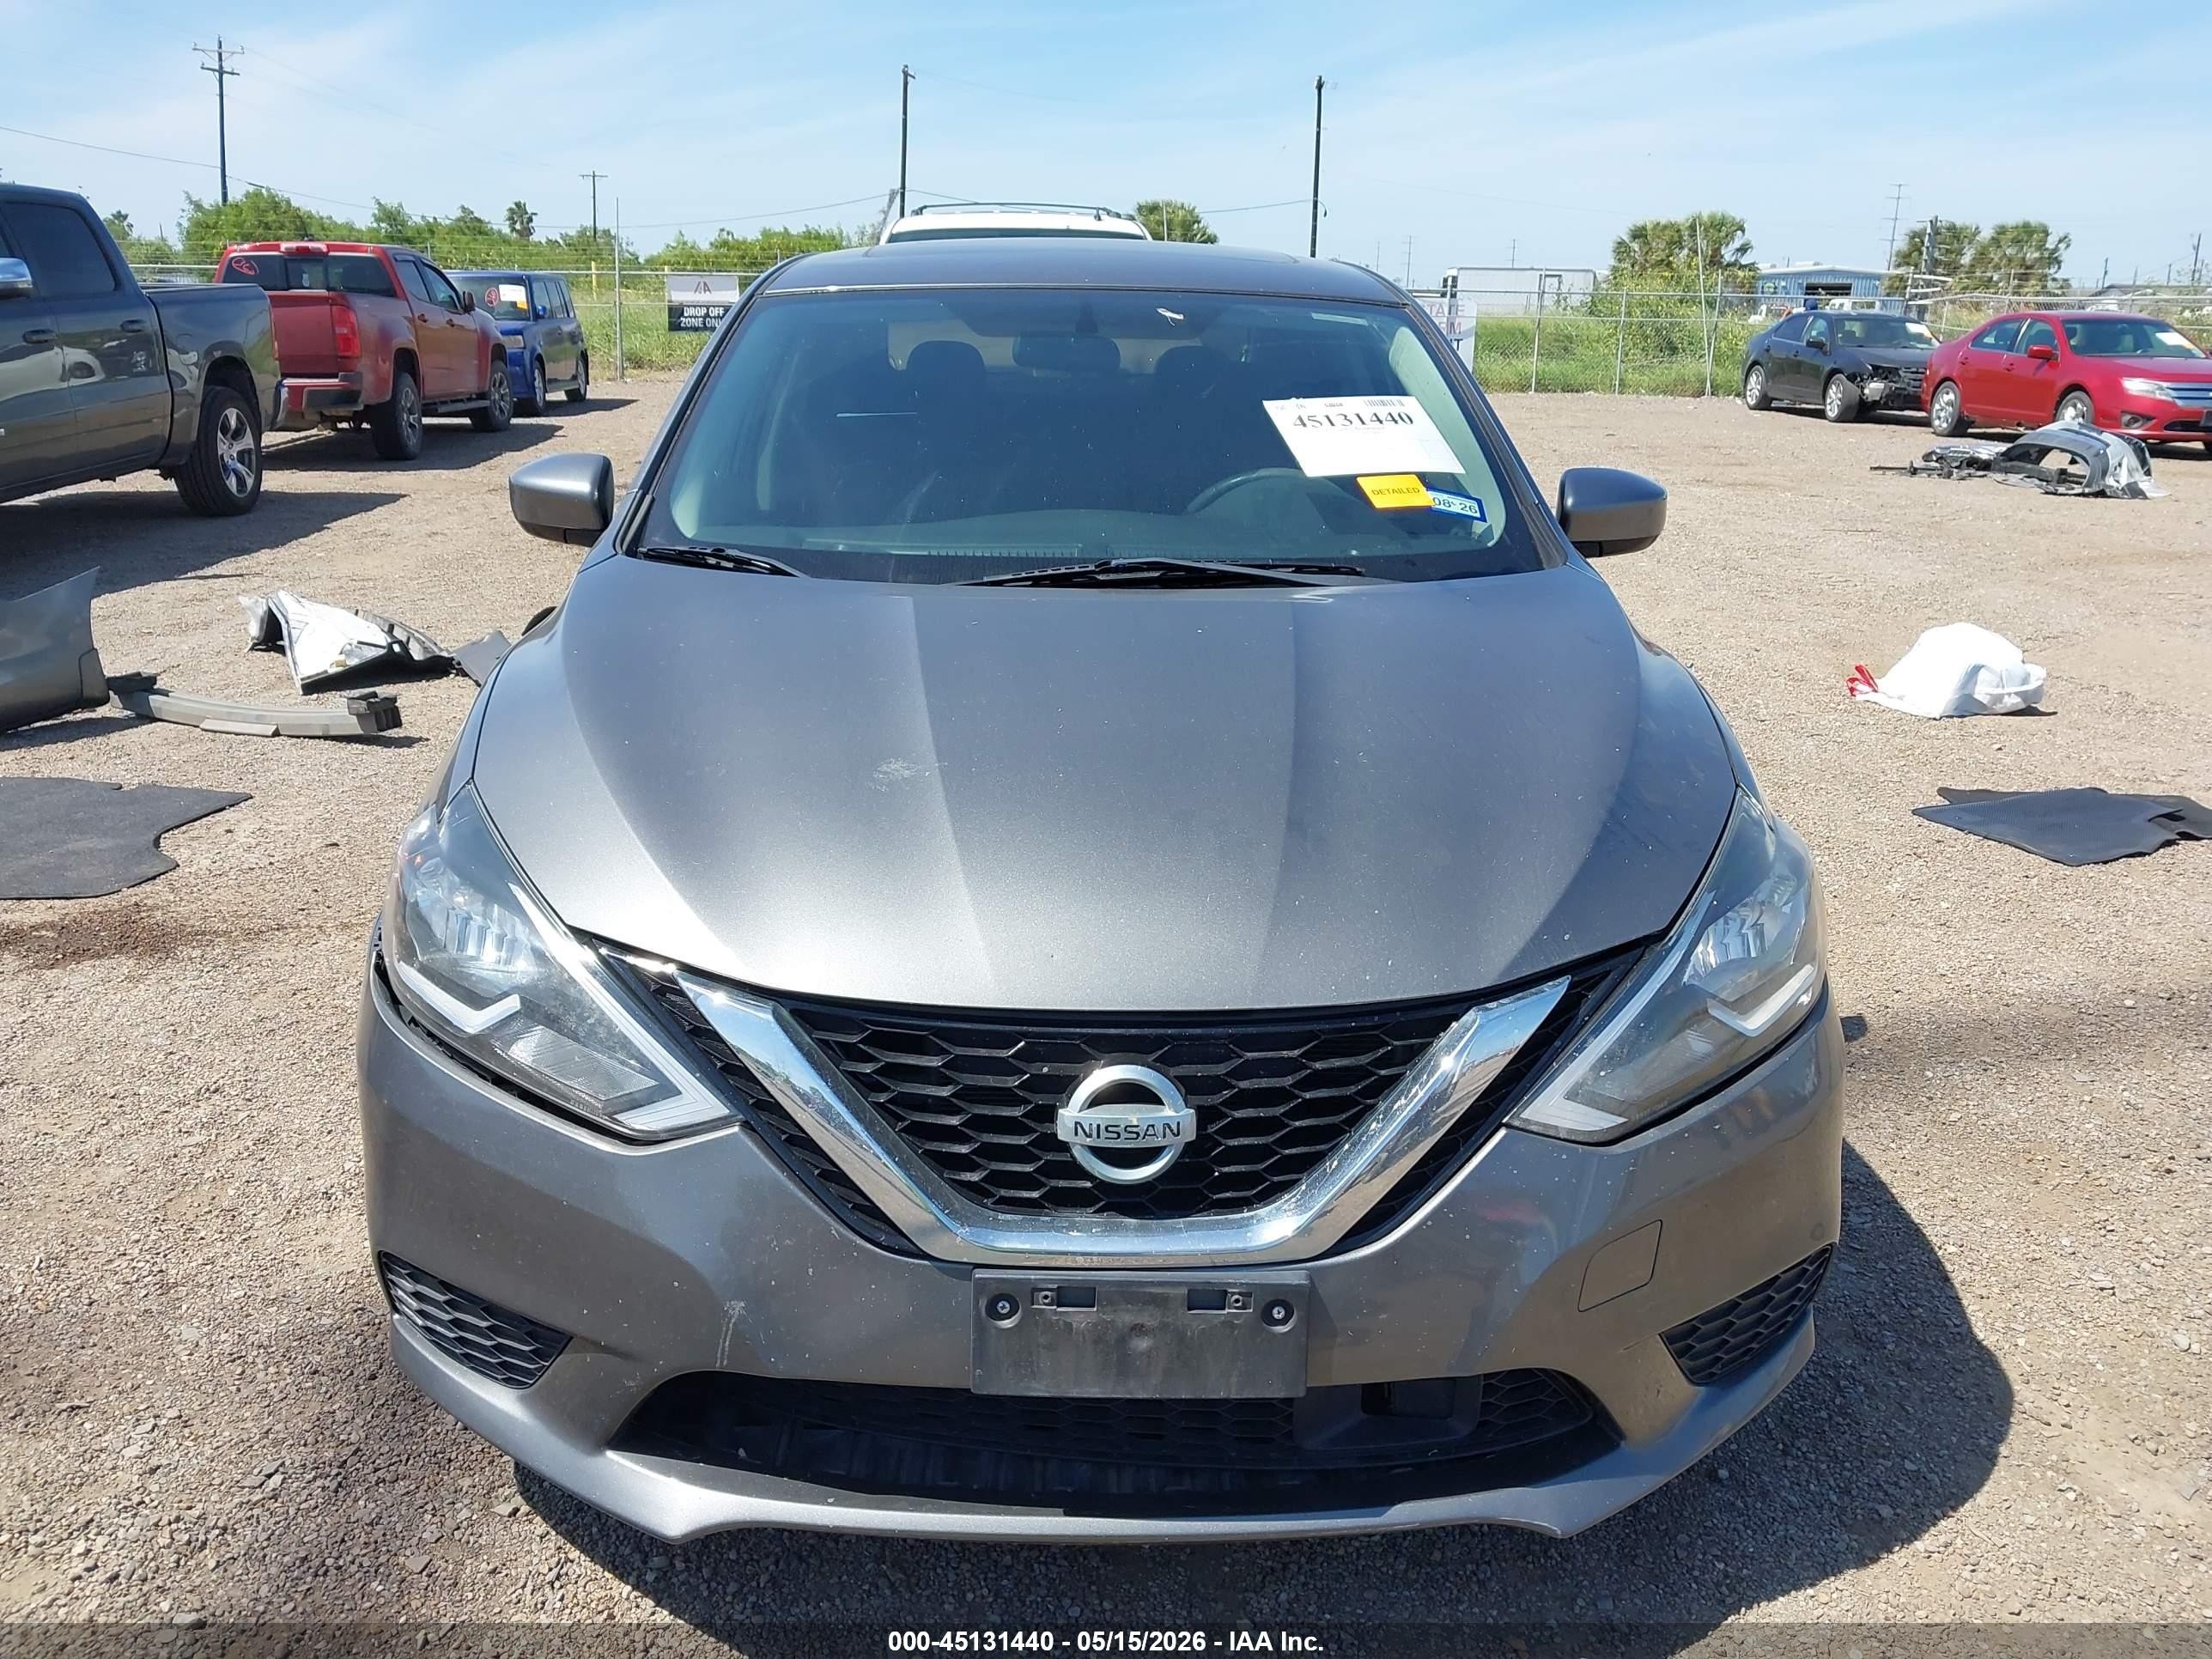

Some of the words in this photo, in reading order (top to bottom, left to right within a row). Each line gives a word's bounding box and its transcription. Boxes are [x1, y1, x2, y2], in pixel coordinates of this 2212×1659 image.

[684, 307, 707, 317] DROP
[708, 307, 725, 317] OFF
[1425, 304, 1465, 316] TATE
[680, 317, 704, 327] ZONE
[1293, 411, 1413, 428] 45131440
[1371, 487, 1420, 495] DETAILED
[1073, 1120, 1182, 1141] NISSAN
